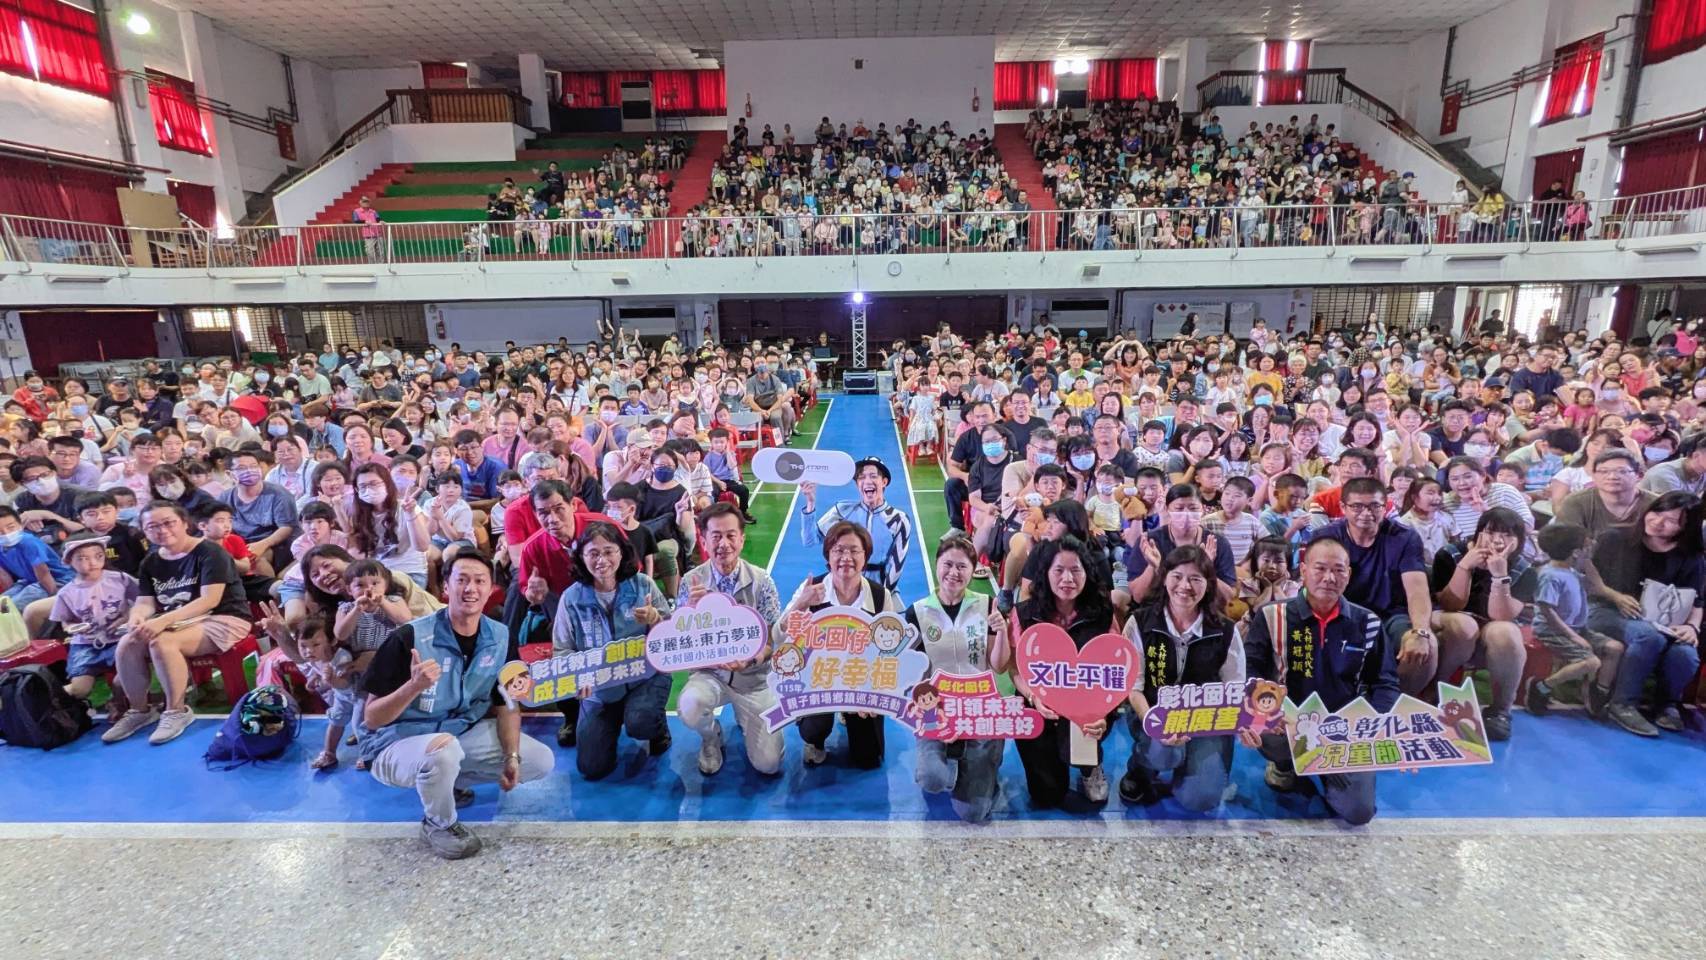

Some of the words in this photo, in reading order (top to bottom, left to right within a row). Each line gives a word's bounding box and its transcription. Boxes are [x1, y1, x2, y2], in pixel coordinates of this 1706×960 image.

[811, 656, 898, 689] 好幸福
[1029, 662, 1126, 690] 文化平權
[944, 697, 1025, 717] 引領未來
[1163, 706, 1242, 735] 熊厲害
[955, 717, 1035, 736] 共創美好
[1352, 712, 1444, 739] 彰化縣
[1319, 736, 1463, 769] 兒童節活動
